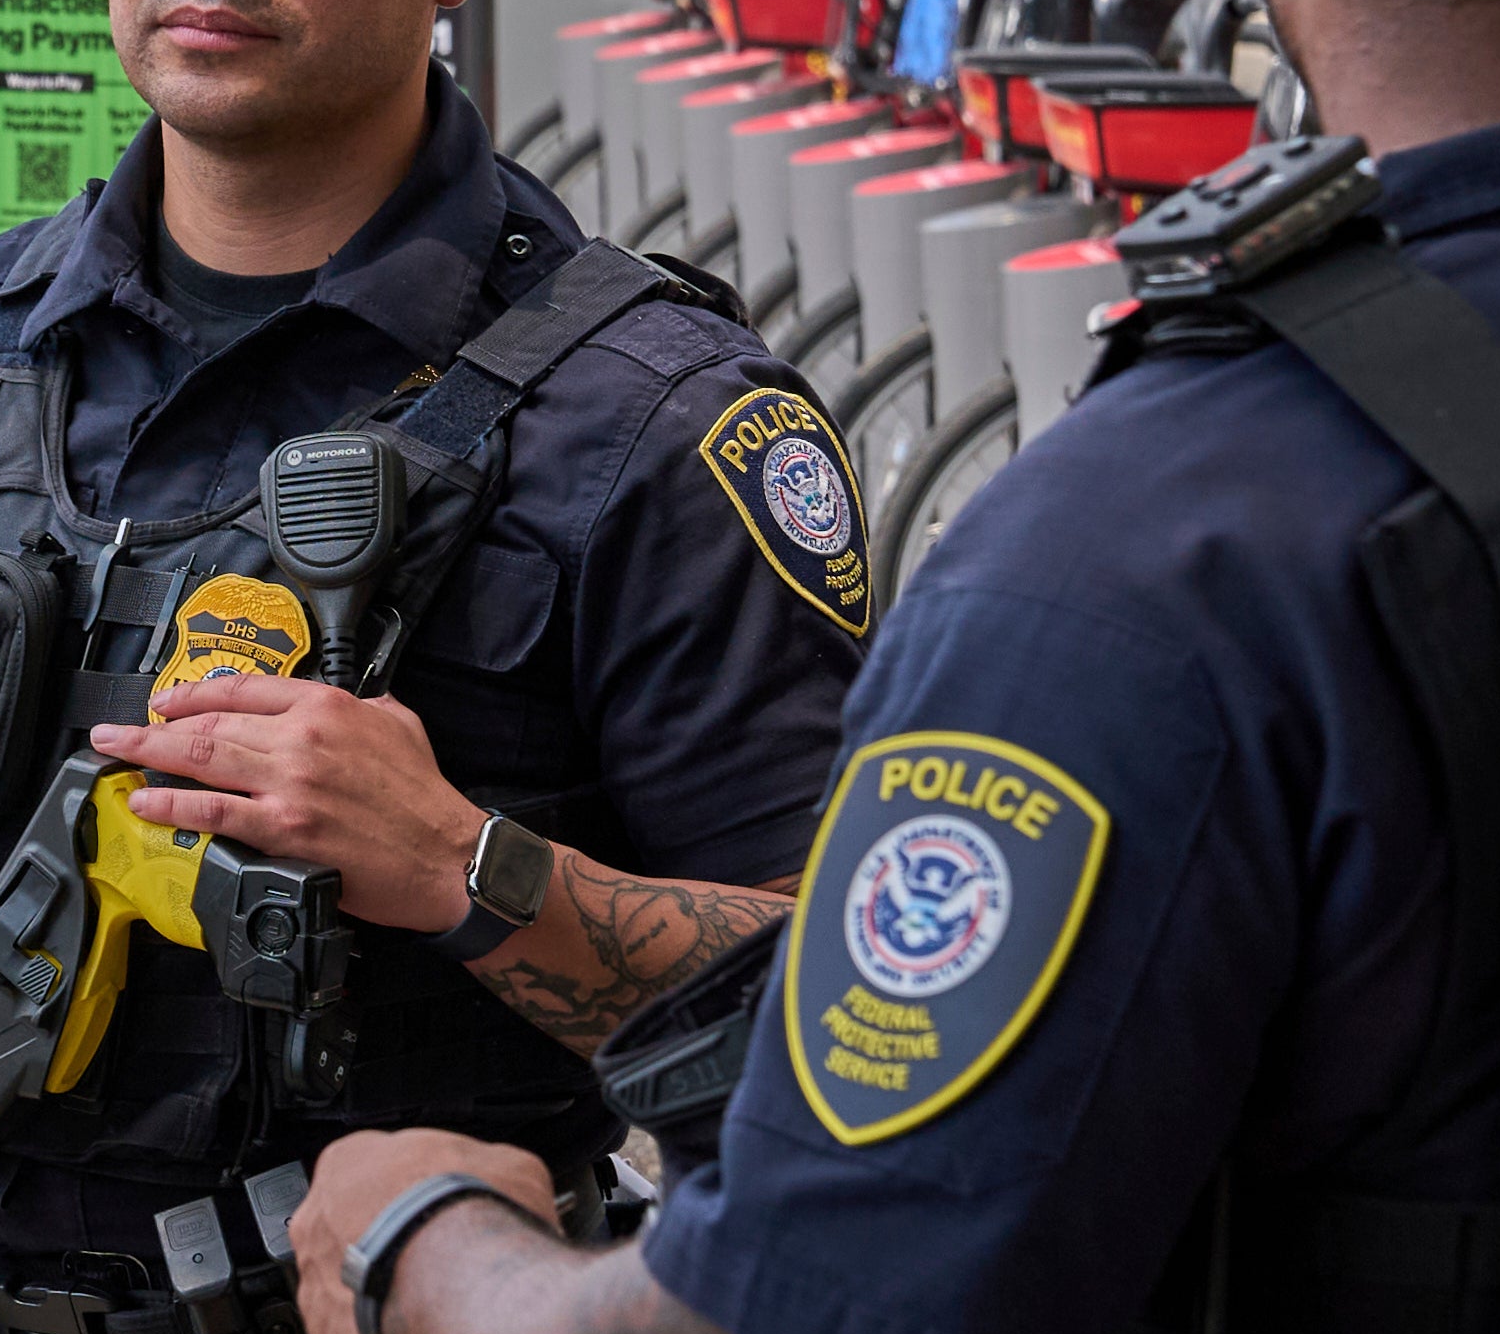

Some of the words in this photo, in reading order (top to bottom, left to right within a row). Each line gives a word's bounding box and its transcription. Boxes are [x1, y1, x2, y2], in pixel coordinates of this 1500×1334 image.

[306, 447, 367, 460] MOTOROLA
[719, 401, 818, 473] POLICE
[190, 637, 218, 650] FEDERAL
[217, 638, 255, 657] PROTECTIVE
[253, 647, 282, 669] SERVICE
[223, 620, 258, 640] DHS
[879, 756, 1061, 840] POLICE
[843, 984, 934, 1032] FEDERAL
[820, 1004, 940, 1060] PROTECTIVE
[825, 1046, 910, 1091] SERVICE
